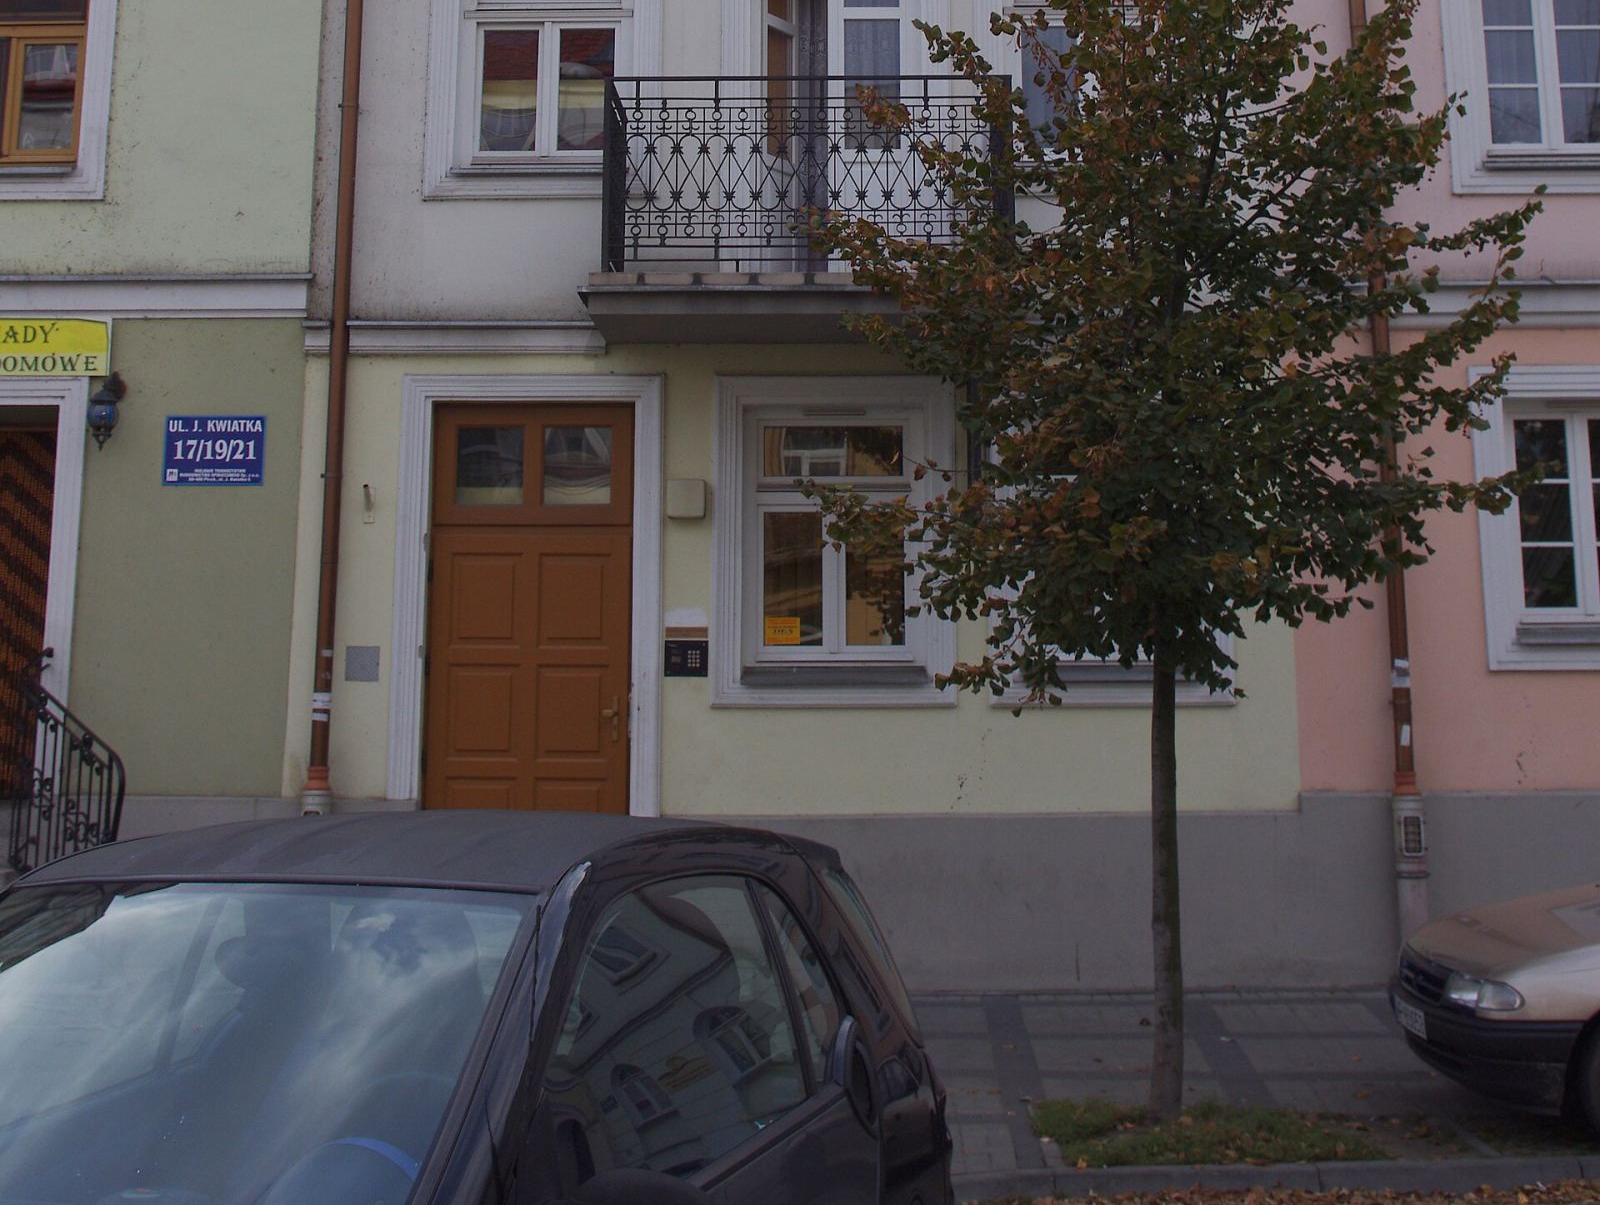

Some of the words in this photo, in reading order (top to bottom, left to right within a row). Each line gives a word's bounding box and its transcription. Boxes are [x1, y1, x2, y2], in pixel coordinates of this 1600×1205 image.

[0, 322, 59, 344] ADY
[0, 352, 98, 373] OMÓWE
[169, 420, 189, 432] UL.
[192, 420, 203, 432] J.
[207, 419, 262, 432] KWIATKA
[173, 439, 257, 462] 17/19/21
